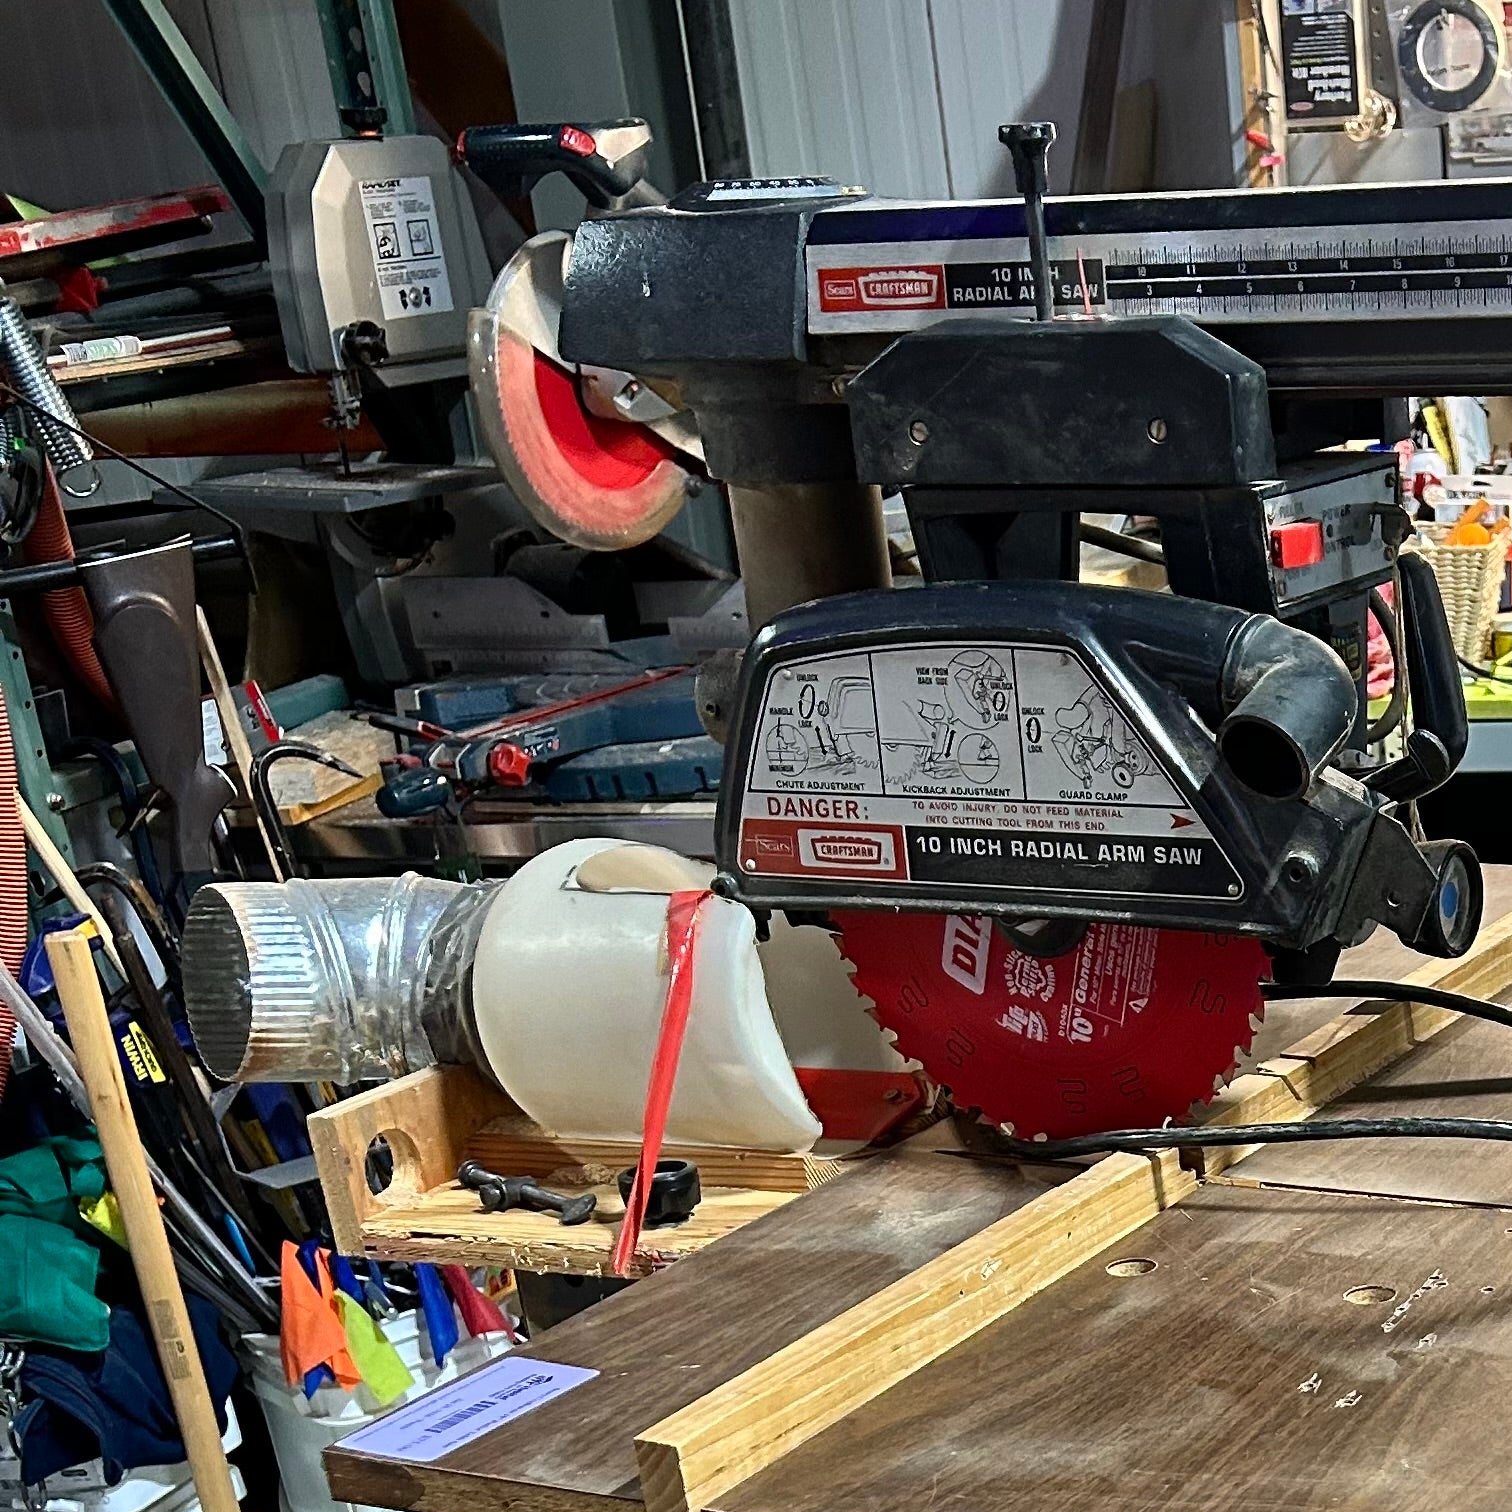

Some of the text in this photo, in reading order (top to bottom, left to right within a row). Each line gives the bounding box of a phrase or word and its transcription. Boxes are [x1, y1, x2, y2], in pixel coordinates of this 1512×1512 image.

[992, 266, 1059, 282] 10 INH
[1138, 267, 1147, 277] 10
[1187, 265, 1196, 275] 11
[1237, 263, 1247, 273] 12
[1288, 262, 1298, 272] 13
[1339, 260, 1349, 270] 14
[1392, 258, 1402, 269] 15
[1445, 257, 1455, 267] 16
[1500, 255, 1509, 266] 17
[869, 281, 928, 296] CRAFTSMAN
[953, 287, 1012, 302] RADIAL
[1062, 284, 1098, 299] SAW
[1147, 284, 1153, 296] 3
[1196, 283, 1203, 294] 4
[1246, 281, 1252, 293] 5
[1297, 280, 1304, 292] 6
[1350, 279, 1356, 291] 7
[1401, 278, 1408, 289] 8
[1454, 276, 1461, 288] 9
[776, 780, 865, 791] CHUTE ADJUSTMENT
[903, 785, 1011, 797] KICKBACK ADJUSTMENT
[1059, 789, 1128, 802] GUARD CLAMP
[767, 796, 870, 821] DANGER:
[912, 801, 925, 810] TO
[929, 802, 958, 812] AVOID
[1004, 805, 1018, 814] DO
[1023, 806, 1041, 815] NOT
[1047, 807, 1070, 816] FEED
[1075, 808, 1124, 818] MATERIAL
[925, 815, 948, 825] INTO
[952, 816, 993, 827] CUTTING
[998, 818, 1021, 828] TOOL
[1026, 819, 1053, 829] FROM
[1059, 821, 1080, 830] THIS
[821, 844, 874, 858] CRAFTSMAN
[916, 837, 1202, 866] 10 INCH RADIAL ARM SAW
[1075, 930, 1095, 1004] General
[1071, 1007, 1093, 1043] 10"
[121, 1034, 148, 1081] IRWIN
